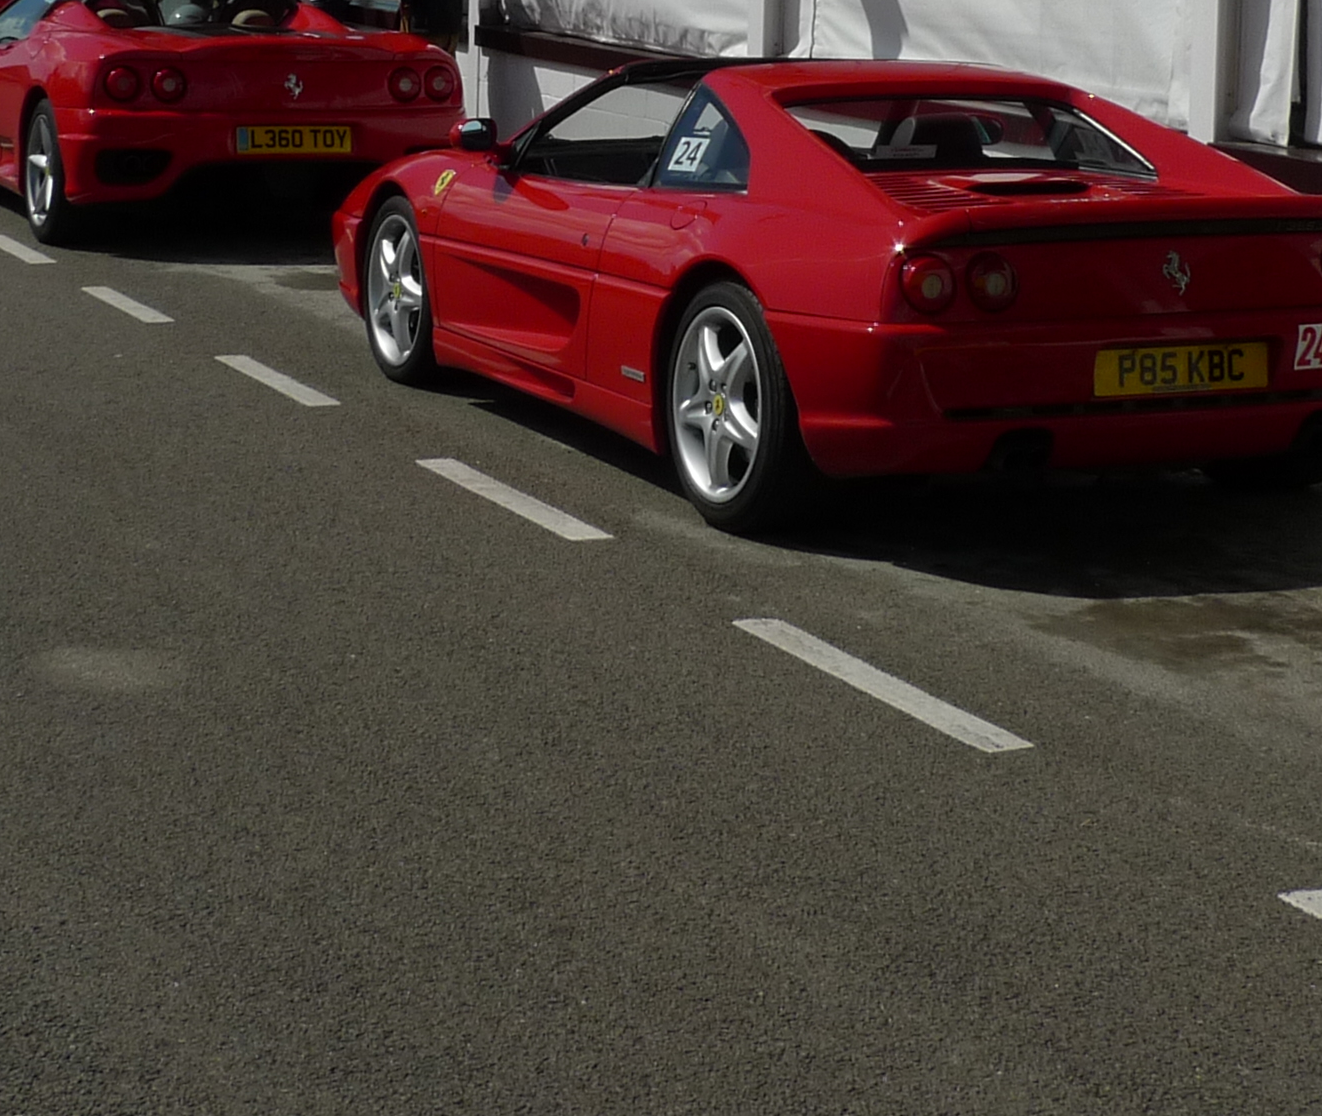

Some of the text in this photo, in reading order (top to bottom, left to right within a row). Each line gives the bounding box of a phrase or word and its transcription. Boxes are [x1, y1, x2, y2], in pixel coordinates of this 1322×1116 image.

[251, 129, 347, 149] L360 TOY
[674, 140, 703, 167] 24
[1117, 348, 1245, 388] P85 KBC
